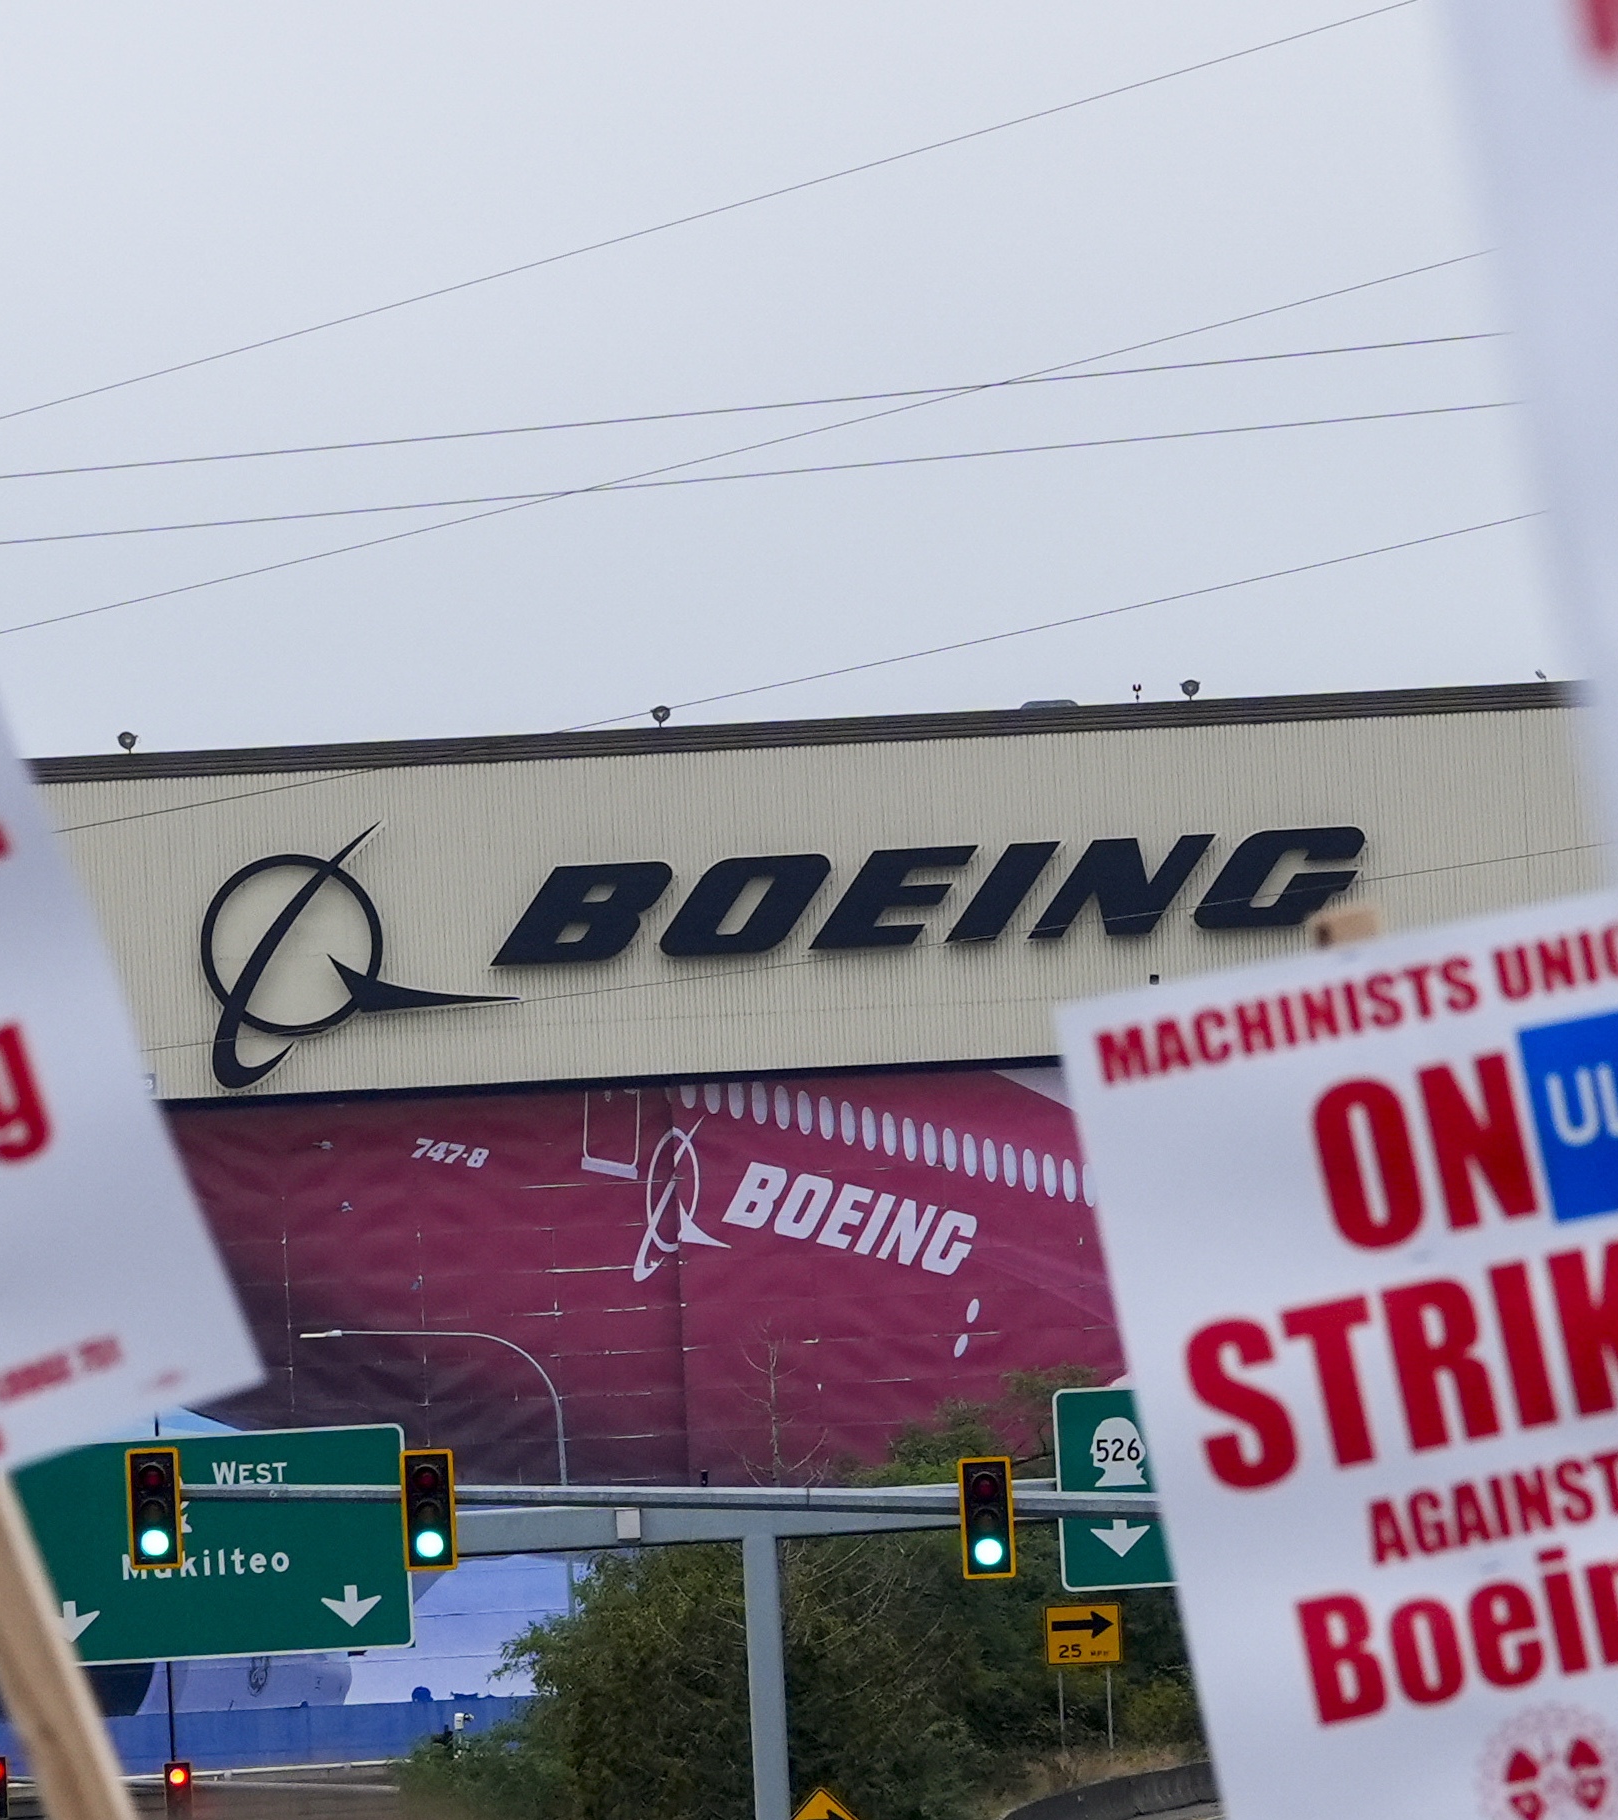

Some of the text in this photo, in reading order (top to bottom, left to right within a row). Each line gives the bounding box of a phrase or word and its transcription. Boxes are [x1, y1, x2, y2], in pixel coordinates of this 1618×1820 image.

[489, 825, 1368, 968] BOEING
[1093, 961, 1483, 1087] MACHINISTS
[410, 1137, 491, 1169] 747-8
[1311, 1050, 1540, 1253] ON
[720, 1160, 979, 1277] BOEING
[212, 1461, 288, 1486] WEST
[1096, 1437, 1141, 1463] 526
[1058, 1643, 1082, 1659] 25
